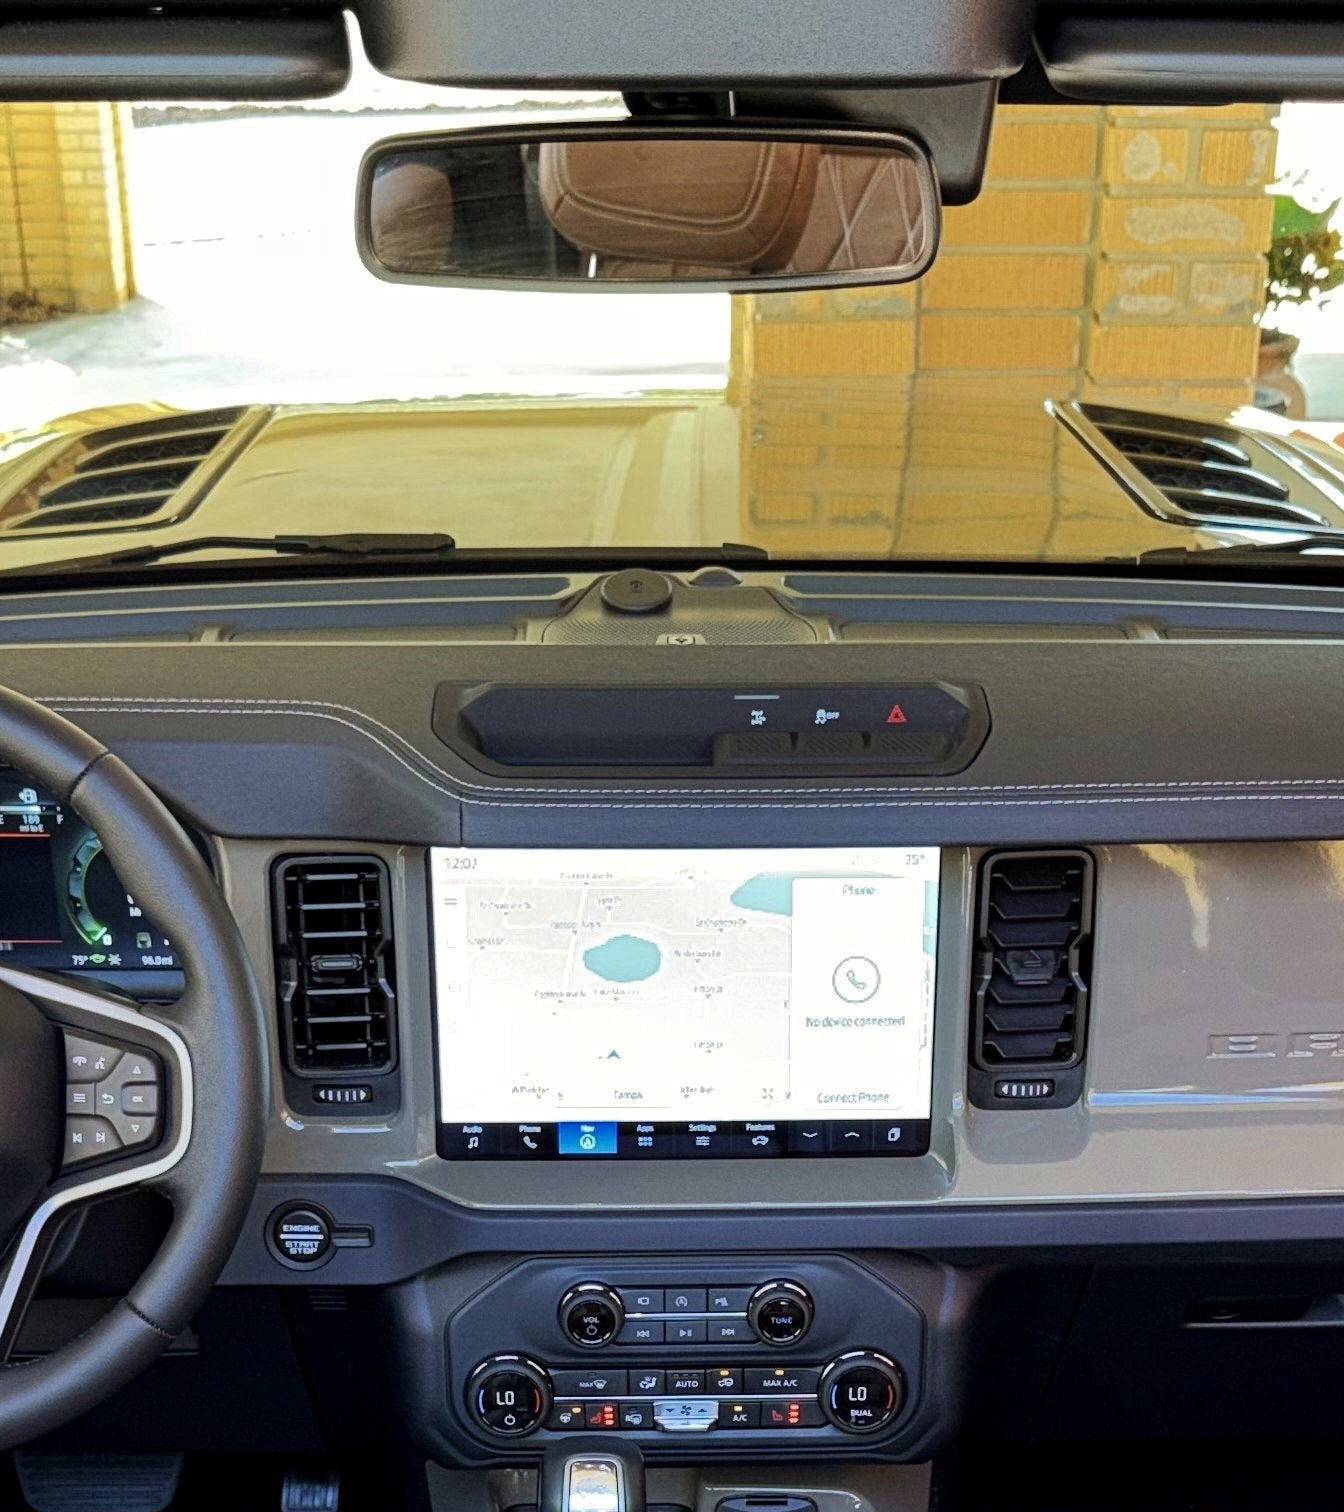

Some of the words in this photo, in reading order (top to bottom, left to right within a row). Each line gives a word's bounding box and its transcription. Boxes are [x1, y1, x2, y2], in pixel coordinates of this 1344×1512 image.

[56, 814, 64, 825] F
[906, 854, 925, 865] 75°
[842, 884, 876, 896] Phone
[806, 1016, 821, 1027] No
[822, 1016, 853, 1027] device
[854, 1016, 905, 1027] connected
[816, 1092, 857, 1103] Connect
[858, 1092, 890, 1103] Phone
[519, 1125, 542, 1133] Phone
[636, 1124, 655, 1134] Apps
[688, 1123, 717, 1133] Settings
[745, 1123, 776, 1132] Features
[282, 1224, 320, 1232] ENGINE
[770, 1316, 793, 1325] TUNE
[675, 1380, 699, 1388] AUTO
[496, 1390, 515, 1406] LO
[848, 1387, 867, 1401] LO
[732, 1414, 748, 1422] A/C
[850, 1409, 873, 1417] DUAL
